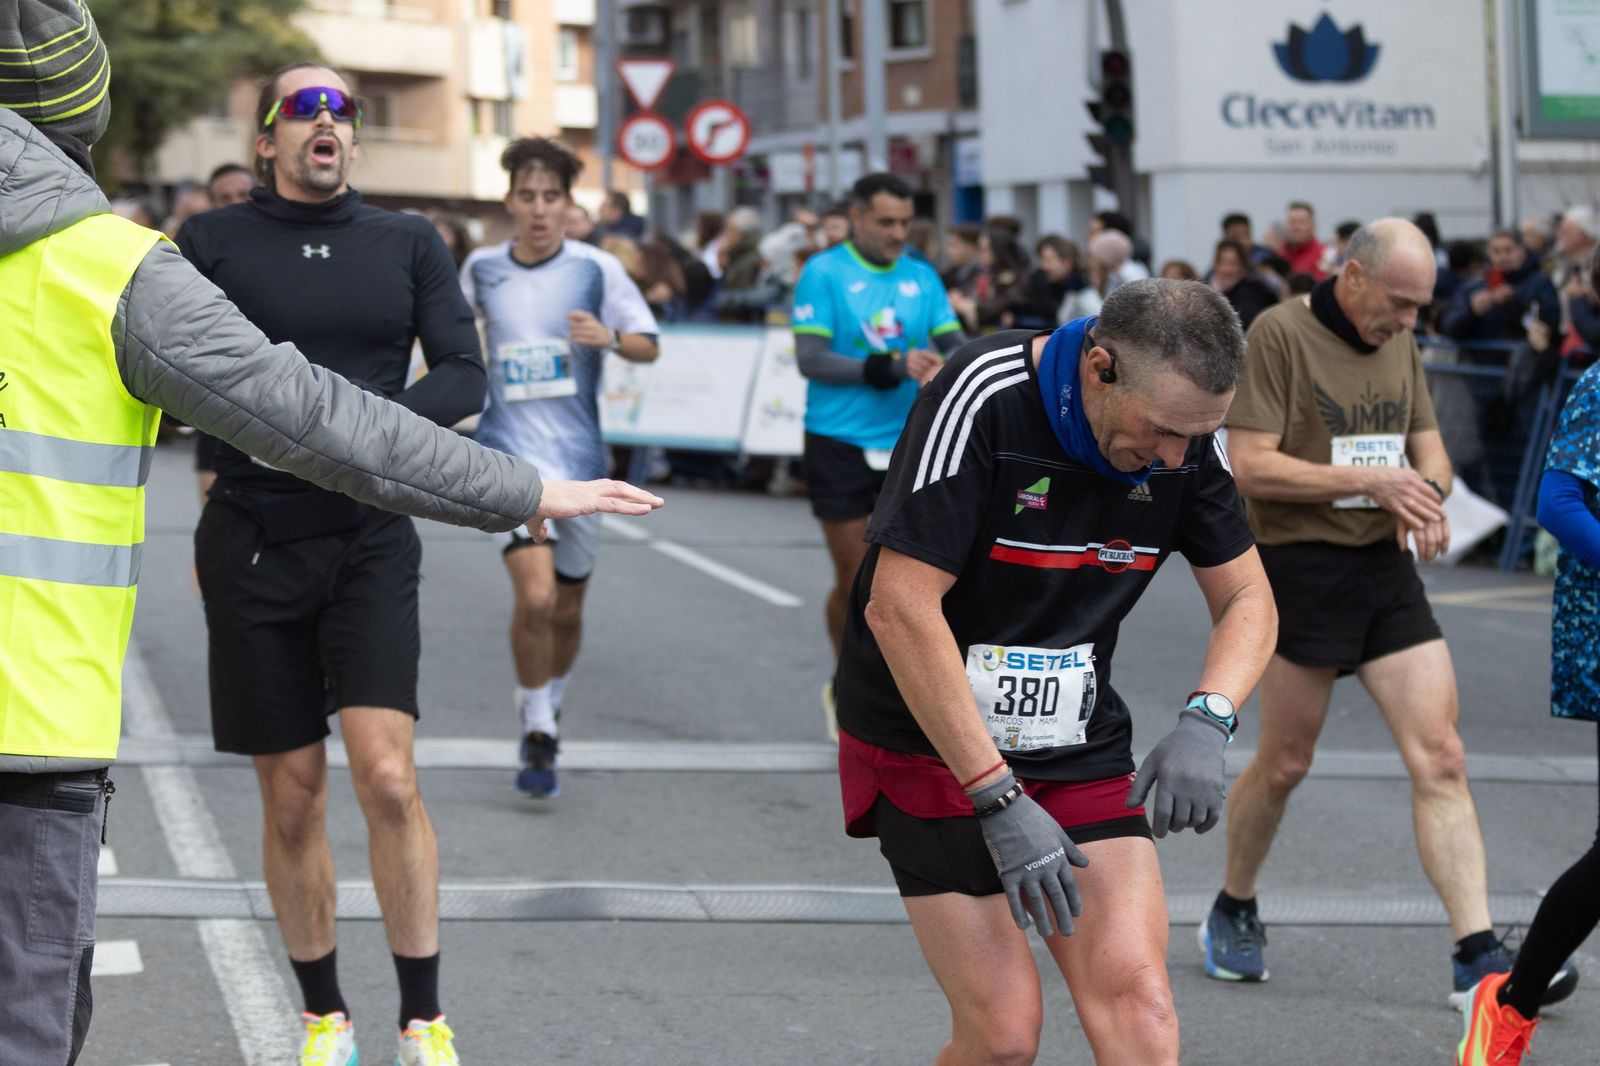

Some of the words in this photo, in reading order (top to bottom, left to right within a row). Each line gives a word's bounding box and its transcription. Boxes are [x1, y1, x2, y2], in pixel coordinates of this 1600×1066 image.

[1221, 93, 1436, 129] CleceVitam
[1265, 136, 1302, 154] San
[1311, 136, 1397, 156] Antonio
[1127, 493, 1153, 502] adidas
[1007, 652, 1085, 671] SETEL
[994, 676, 1060, 716] 380
[987, 715, 1024, 726] MARCOS
[1029, 718, 1036, 726] Y
